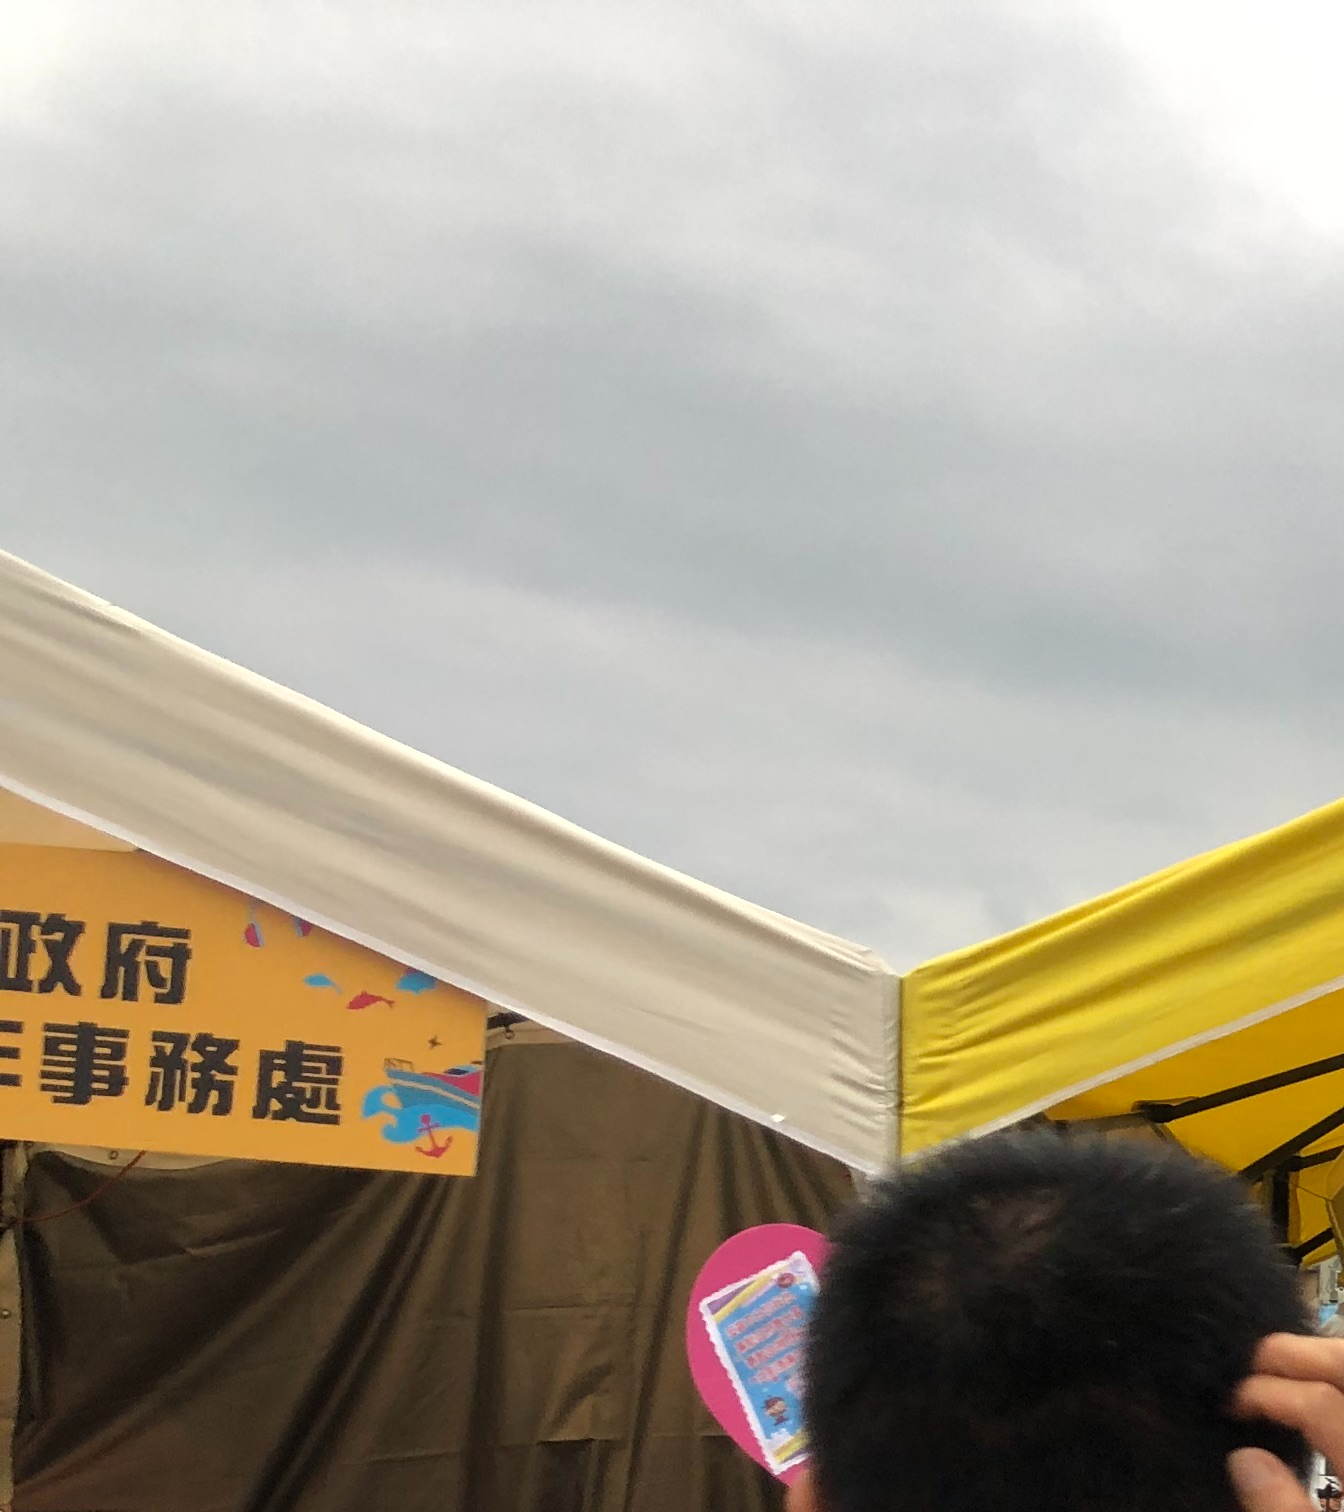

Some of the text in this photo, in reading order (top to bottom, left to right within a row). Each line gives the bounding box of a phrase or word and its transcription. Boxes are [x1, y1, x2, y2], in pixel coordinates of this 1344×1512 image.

[0, 909, 192, 1005] 政府
[0, 1018, 345, 1127] 事務處
